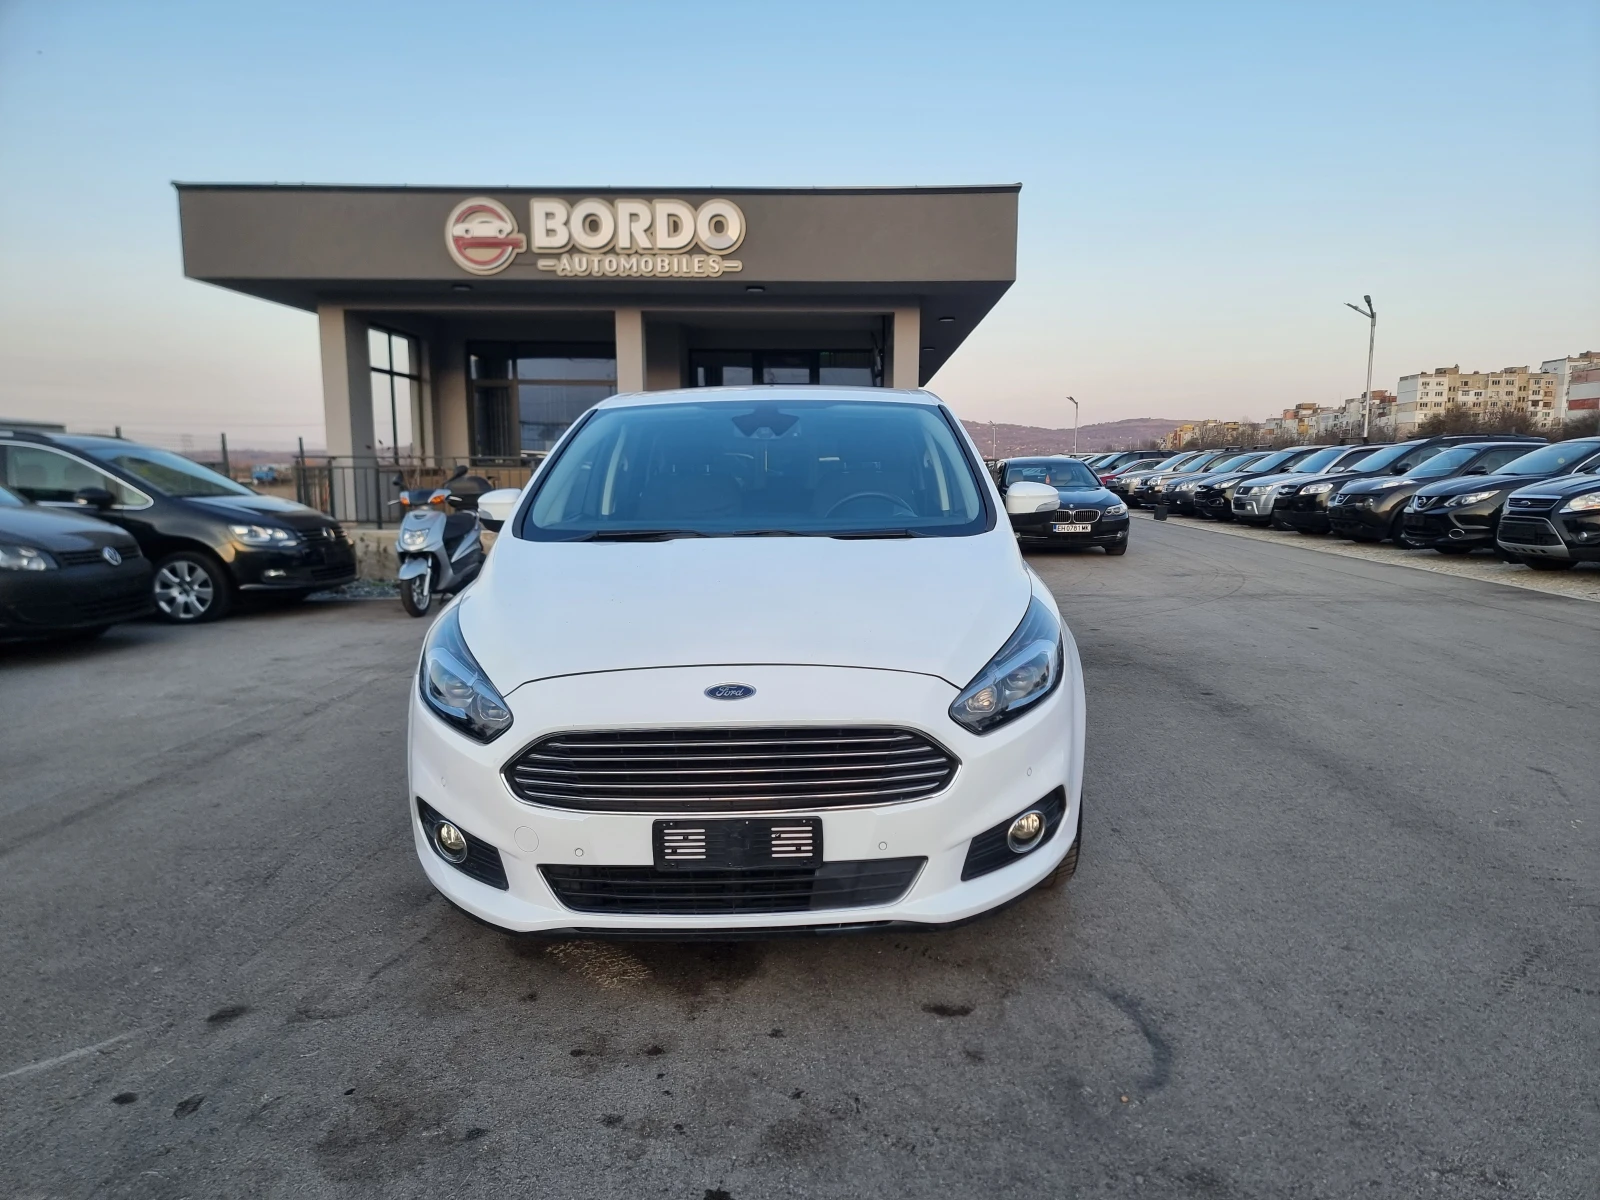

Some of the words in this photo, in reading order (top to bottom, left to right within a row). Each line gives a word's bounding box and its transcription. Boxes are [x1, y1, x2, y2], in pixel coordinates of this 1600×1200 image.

[532, 200, 742, 251] BORDO
[559, 255, 721, 274] AUTOMOBILES
[716, 686, 744, 697] Ford
